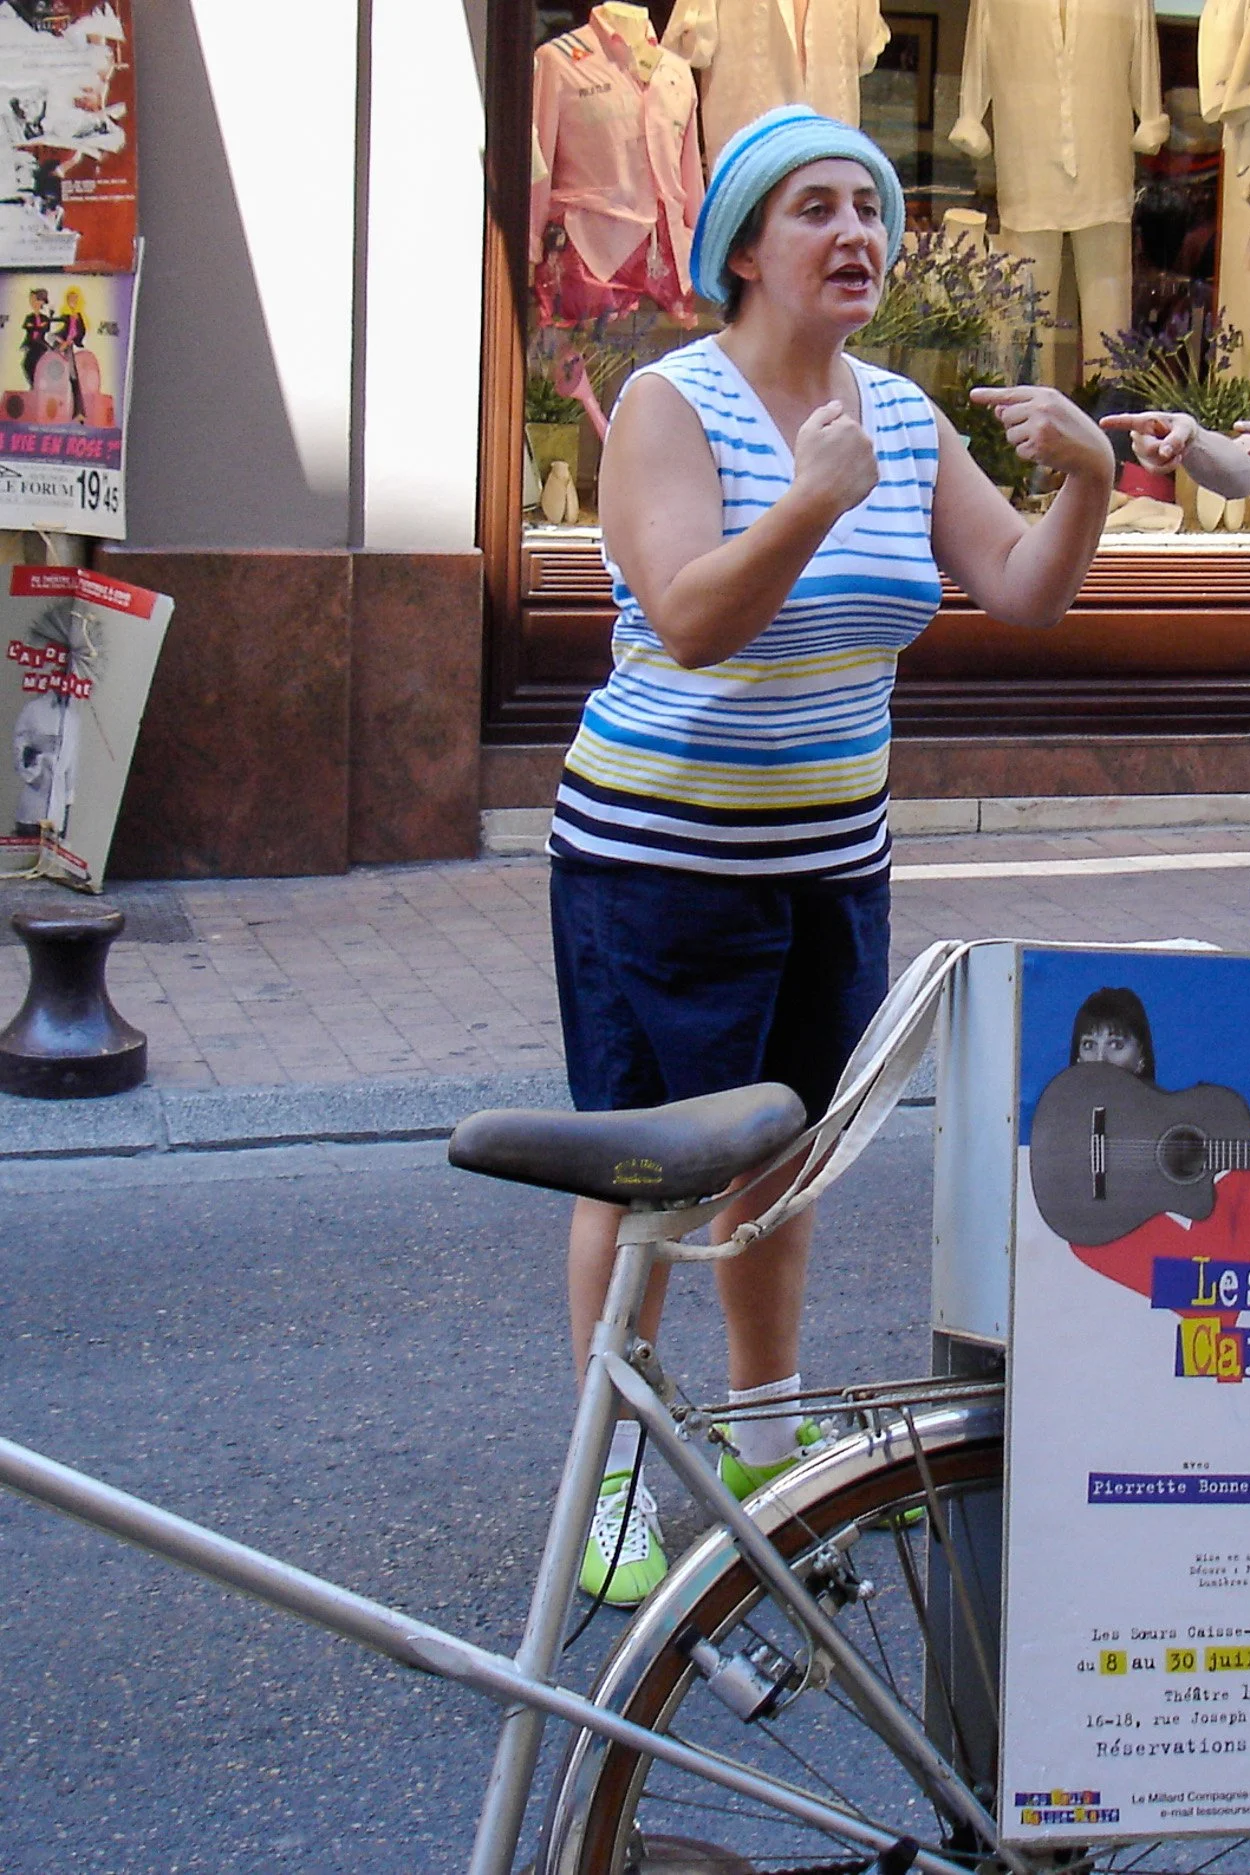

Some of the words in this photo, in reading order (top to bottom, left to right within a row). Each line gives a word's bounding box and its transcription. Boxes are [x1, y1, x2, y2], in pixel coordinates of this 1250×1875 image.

[21, 481, 74, 498] FORUM
[1093, 1480, 1187, 1495] Pierrette
[1092, 1628, 1120, 1641] Les
[1077, 1659, 1096, 1672] du
[1106, 1653, 1118, 1672] 8
[1132, 1656, 1156, 1670] au
[1170, 1653, 1195, 1670] 30
[1164, 1686, 1230, 1702] Théâtre
[1153, 1714, 1181, 1726] rue
[1191, 1709, 1247, 1726] Joseph
[1096, 1738, 1248, 1757] Réservations
